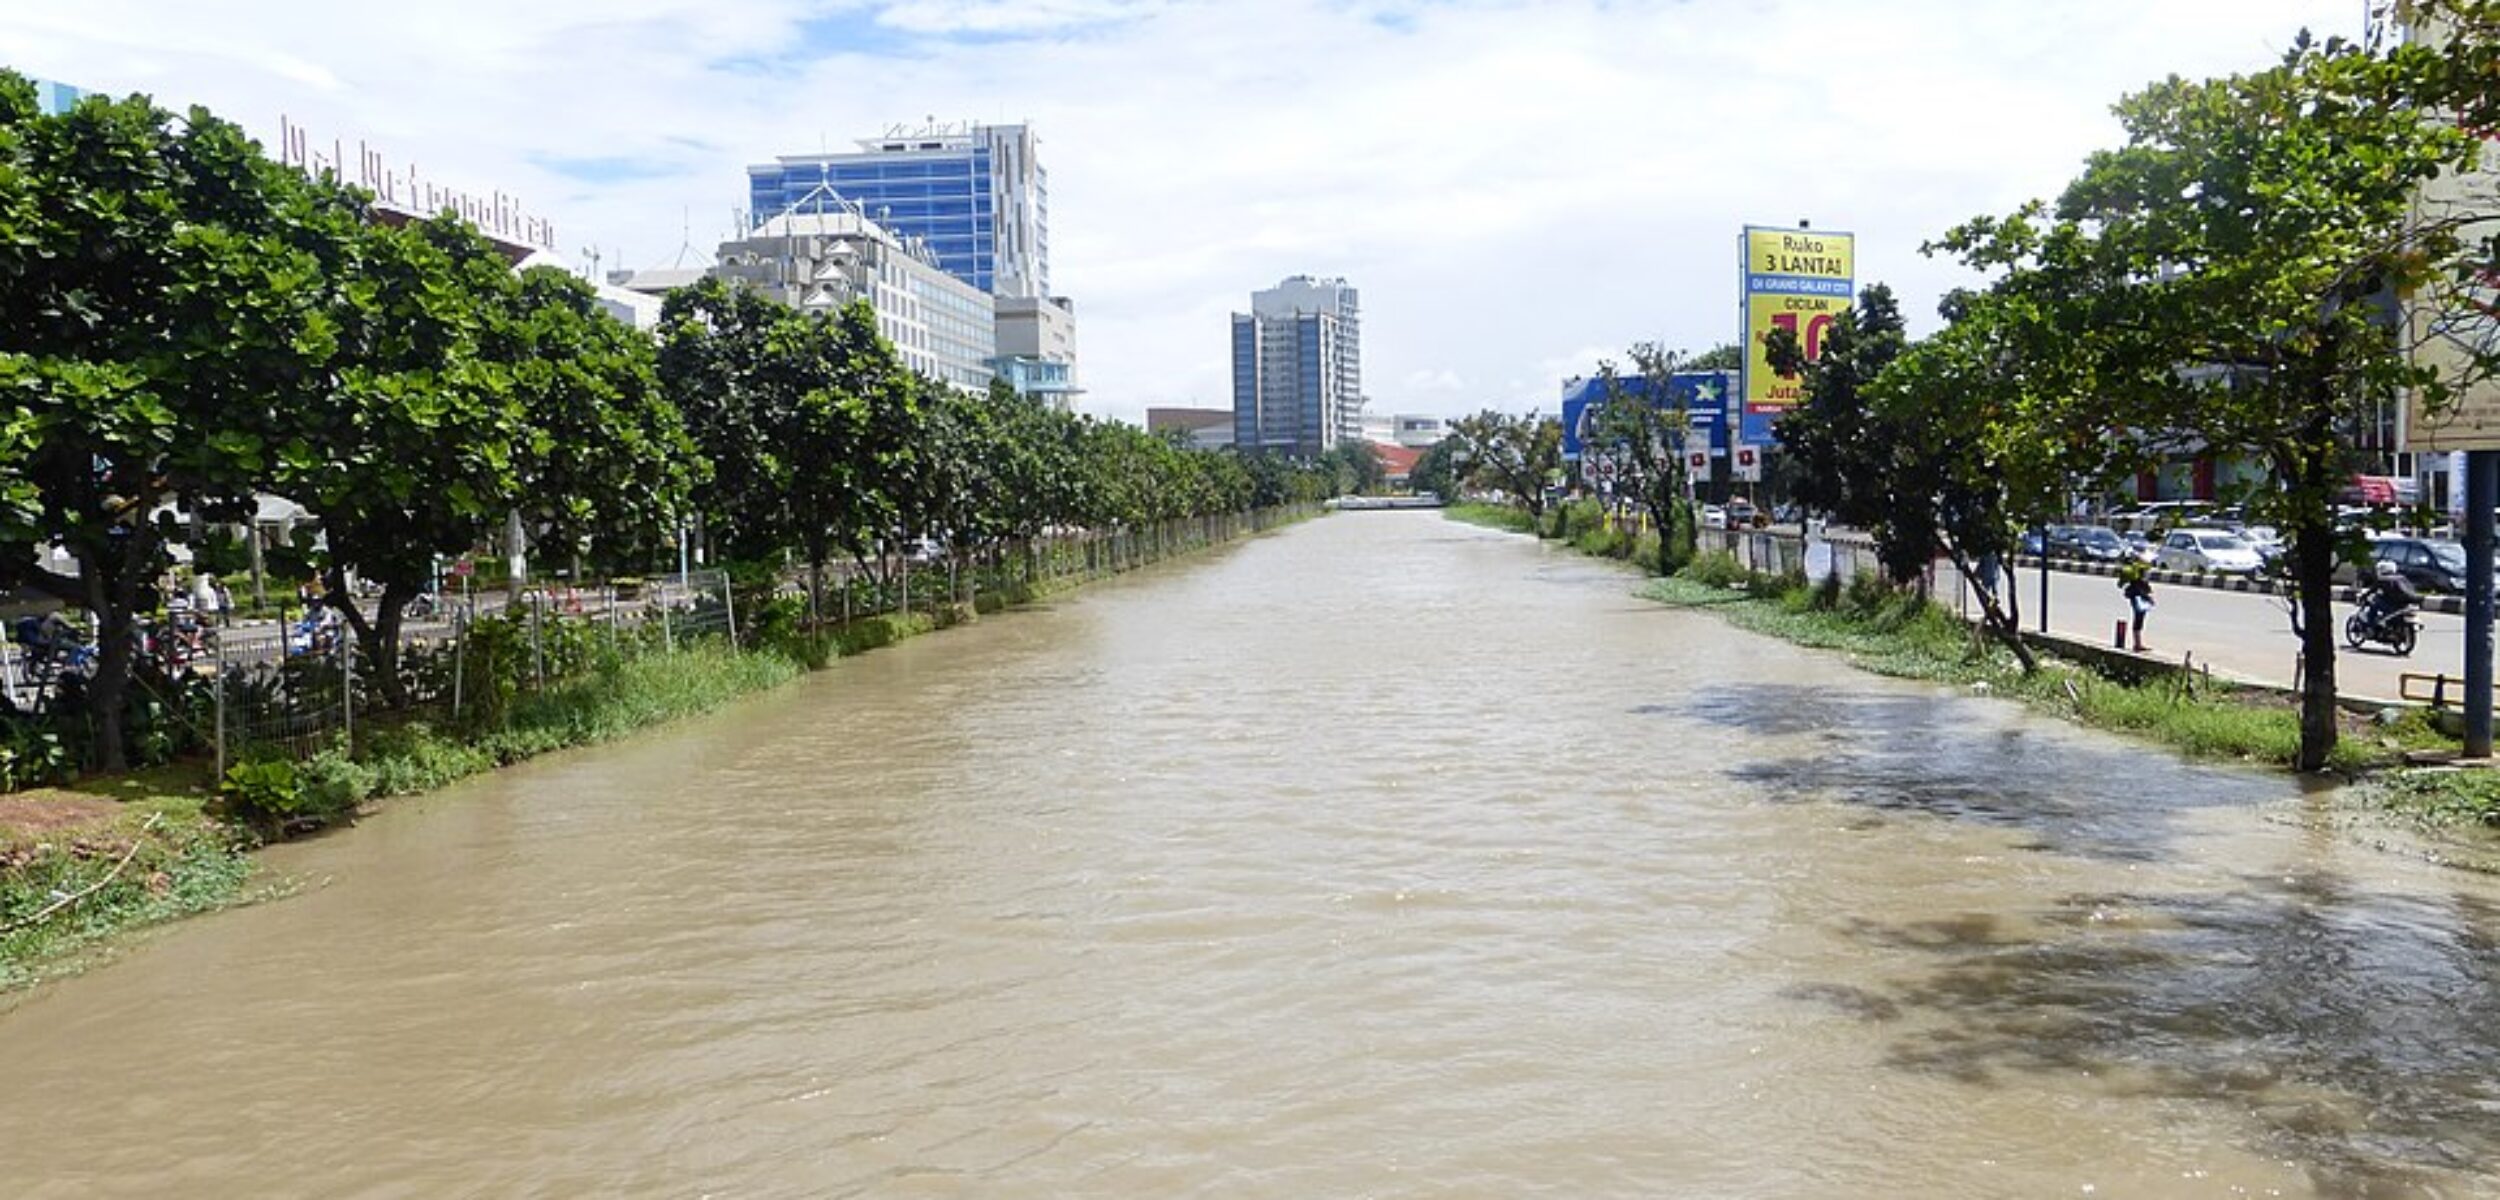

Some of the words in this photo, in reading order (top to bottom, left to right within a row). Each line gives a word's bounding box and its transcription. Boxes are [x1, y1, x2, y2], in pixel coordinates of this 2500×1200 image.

[1783, 235, 1824, 253] Ruko
[1765, 254, 1777, 271] 3
[1781, 255, 1842, 275] LANTAI
[1752, 278, 1763, 290] DI
[1765, 278, 1798, 291] GRAND
[1799, 280, 1831, 292] GALAXY
[1785, 297, 1829, 310] CICILAN
